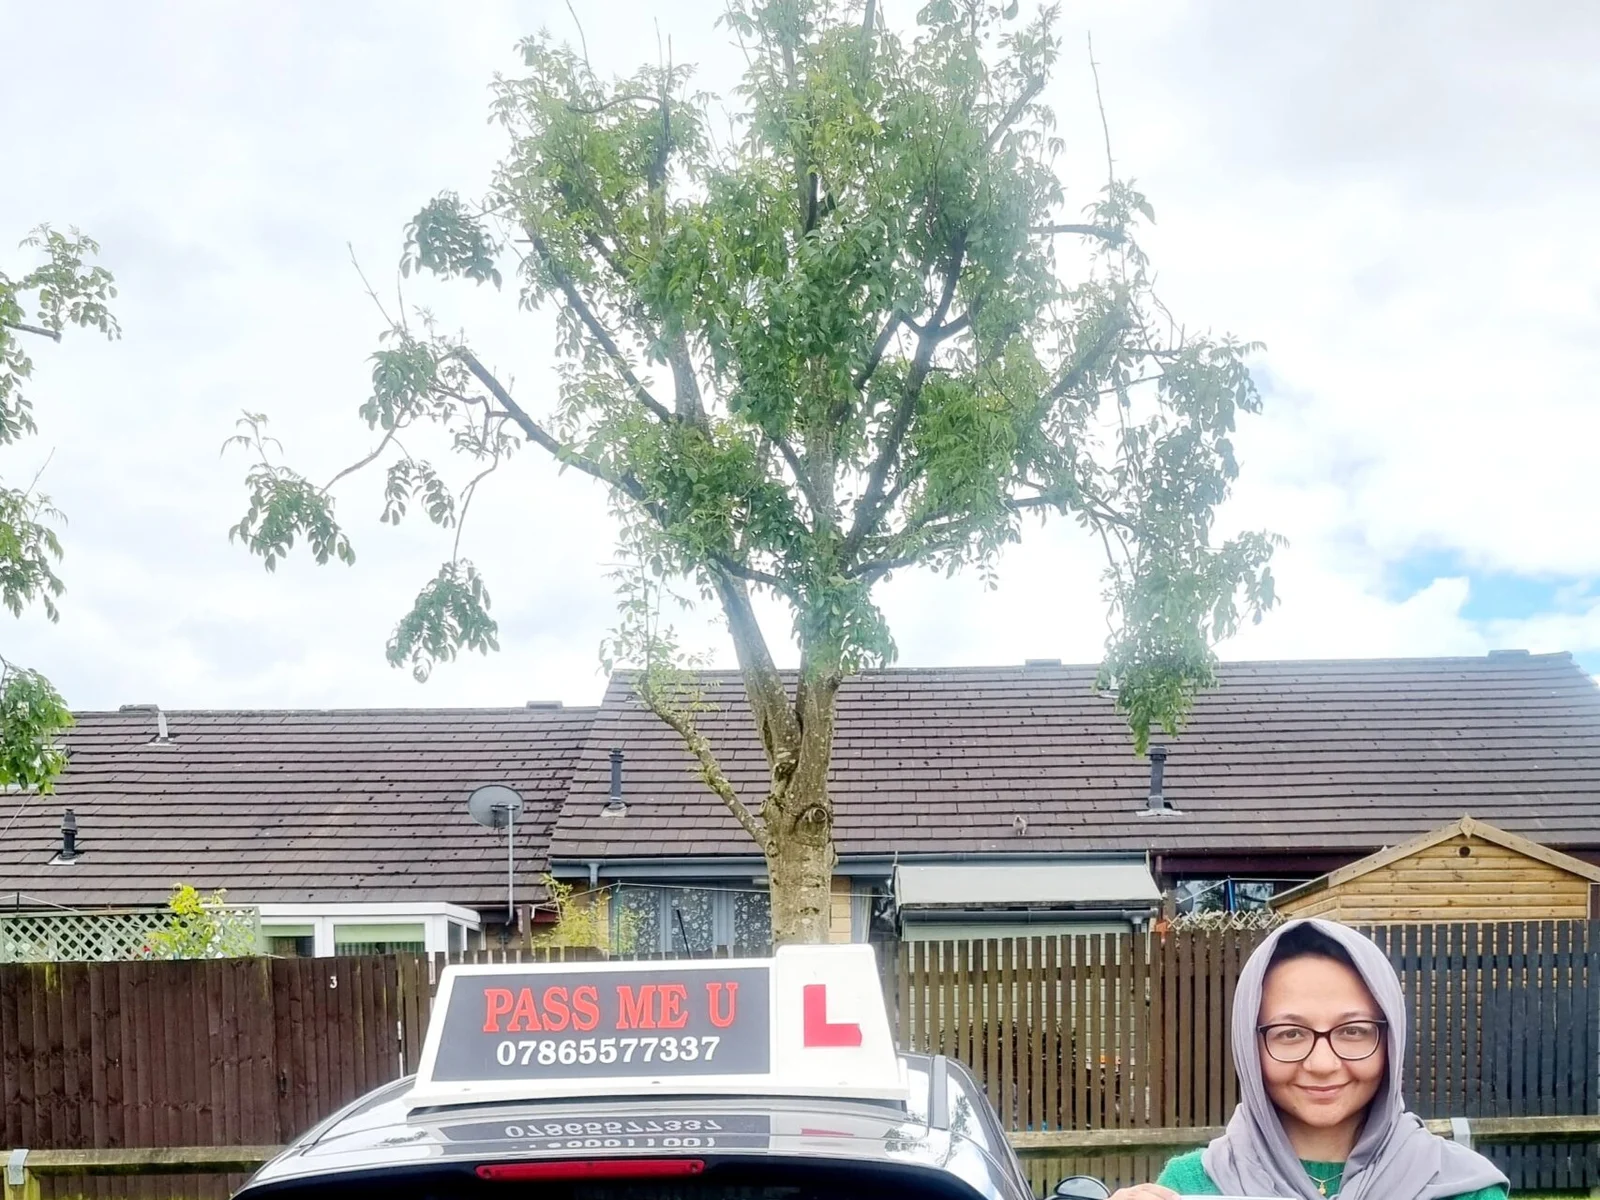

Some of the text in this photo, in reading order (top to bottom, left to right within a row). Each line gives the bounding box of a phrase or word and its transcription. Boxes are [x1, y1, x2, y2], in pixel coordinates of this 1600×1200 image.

[330, 976, 337, 988] 3
[483, 982, 738, 1032] PASS ME U
[803, 984, 862, 1047] L
[497, 1036, 720, 1066] 07865577337
